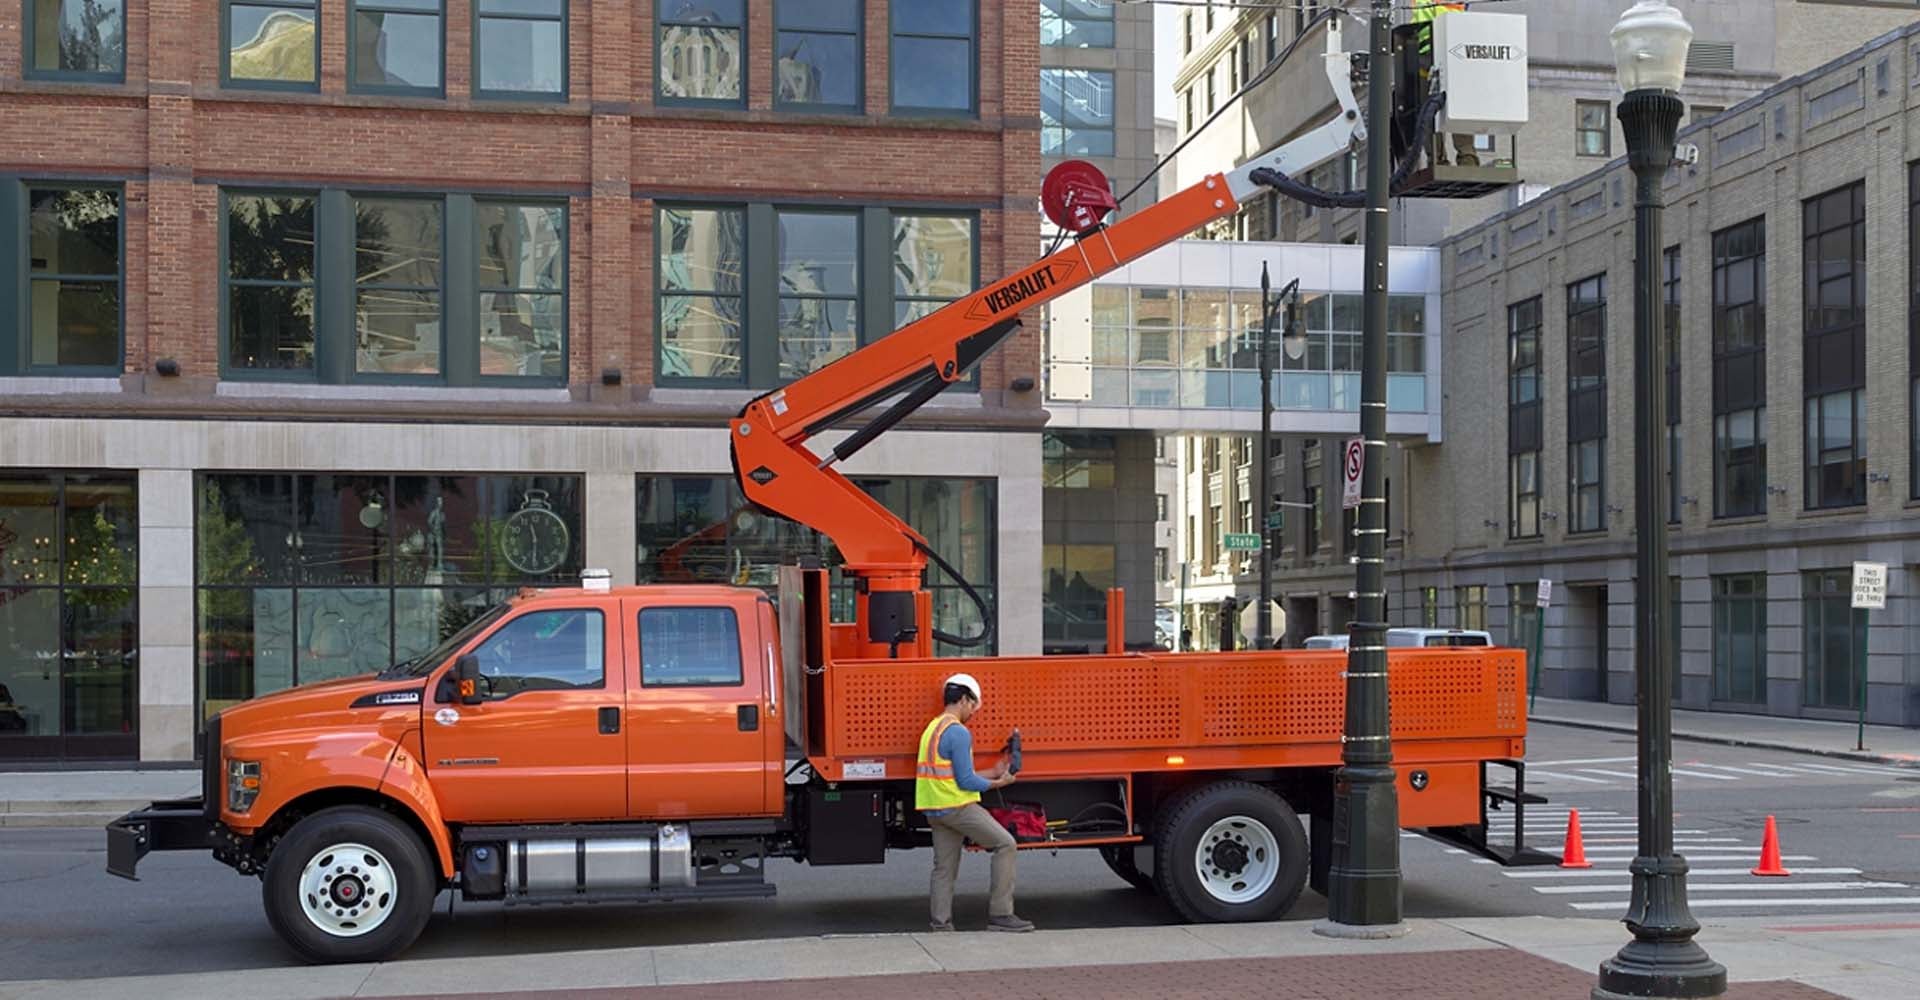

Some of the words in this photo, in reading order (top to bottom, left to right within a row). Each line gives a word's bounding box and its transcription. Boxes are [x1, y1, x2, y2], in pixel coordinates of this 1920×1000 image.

[1465, 45, 1511, 60] VERSALIFT
[984, 265, 1056, 314] VERSALIFT
[1230, 537, 1253, 547] State
[1859, 577, 1880, 585] STREET
